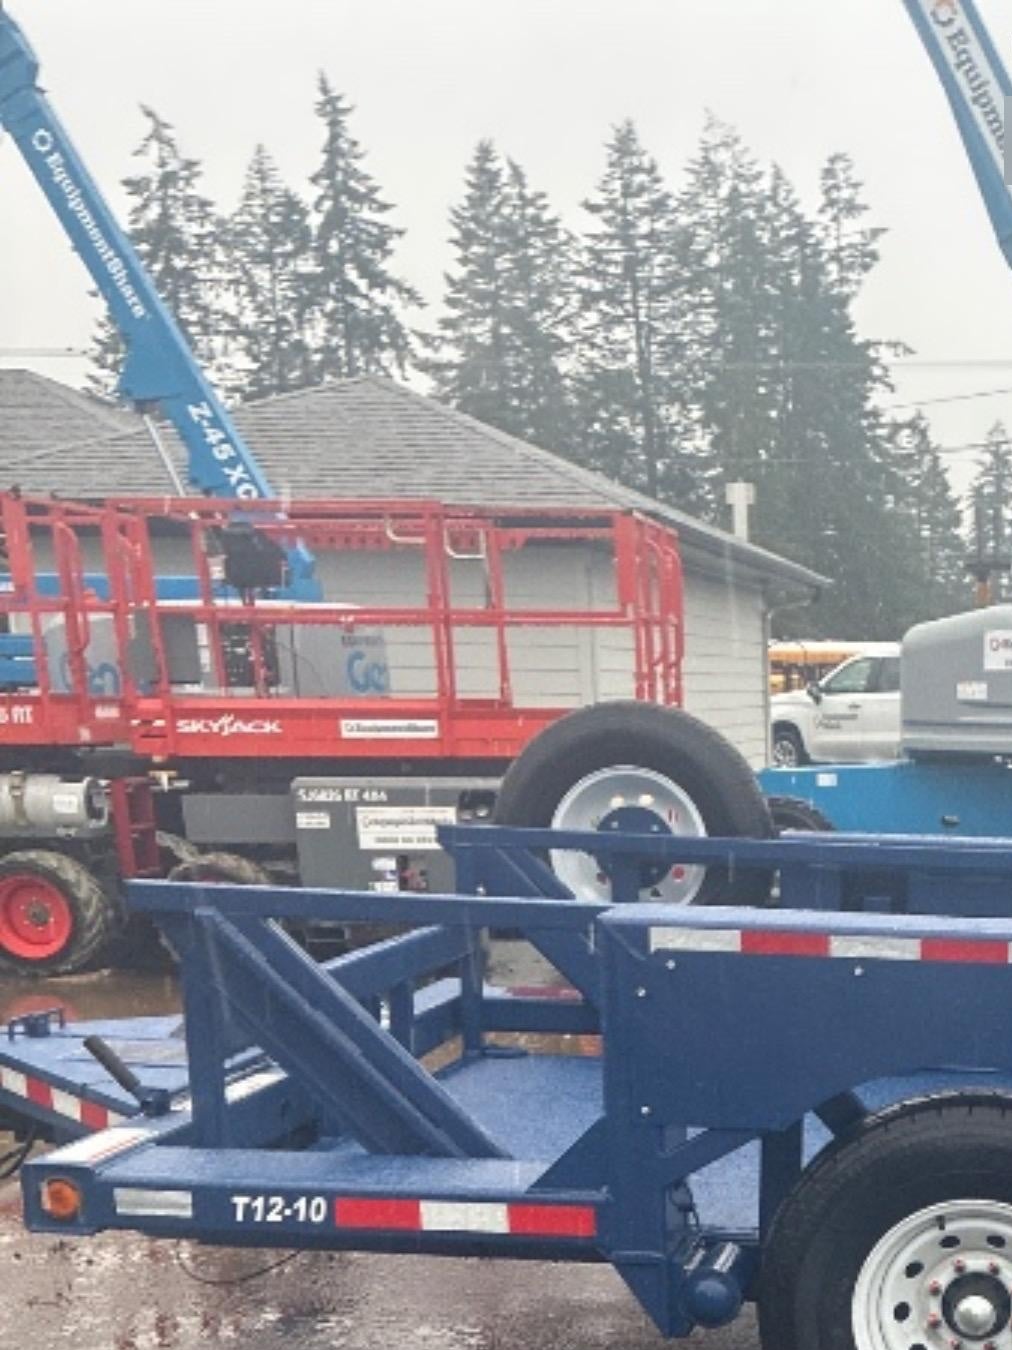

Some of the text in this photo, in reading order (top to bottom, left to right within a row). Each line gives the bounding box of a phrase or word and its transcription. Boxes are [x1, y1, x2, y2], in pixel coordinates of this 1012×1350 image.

[186, 401, 237, 461] Z-45
[176, 713, 282, 736] SKYJACK
[231, 1195, 327, 1223] T12-10
